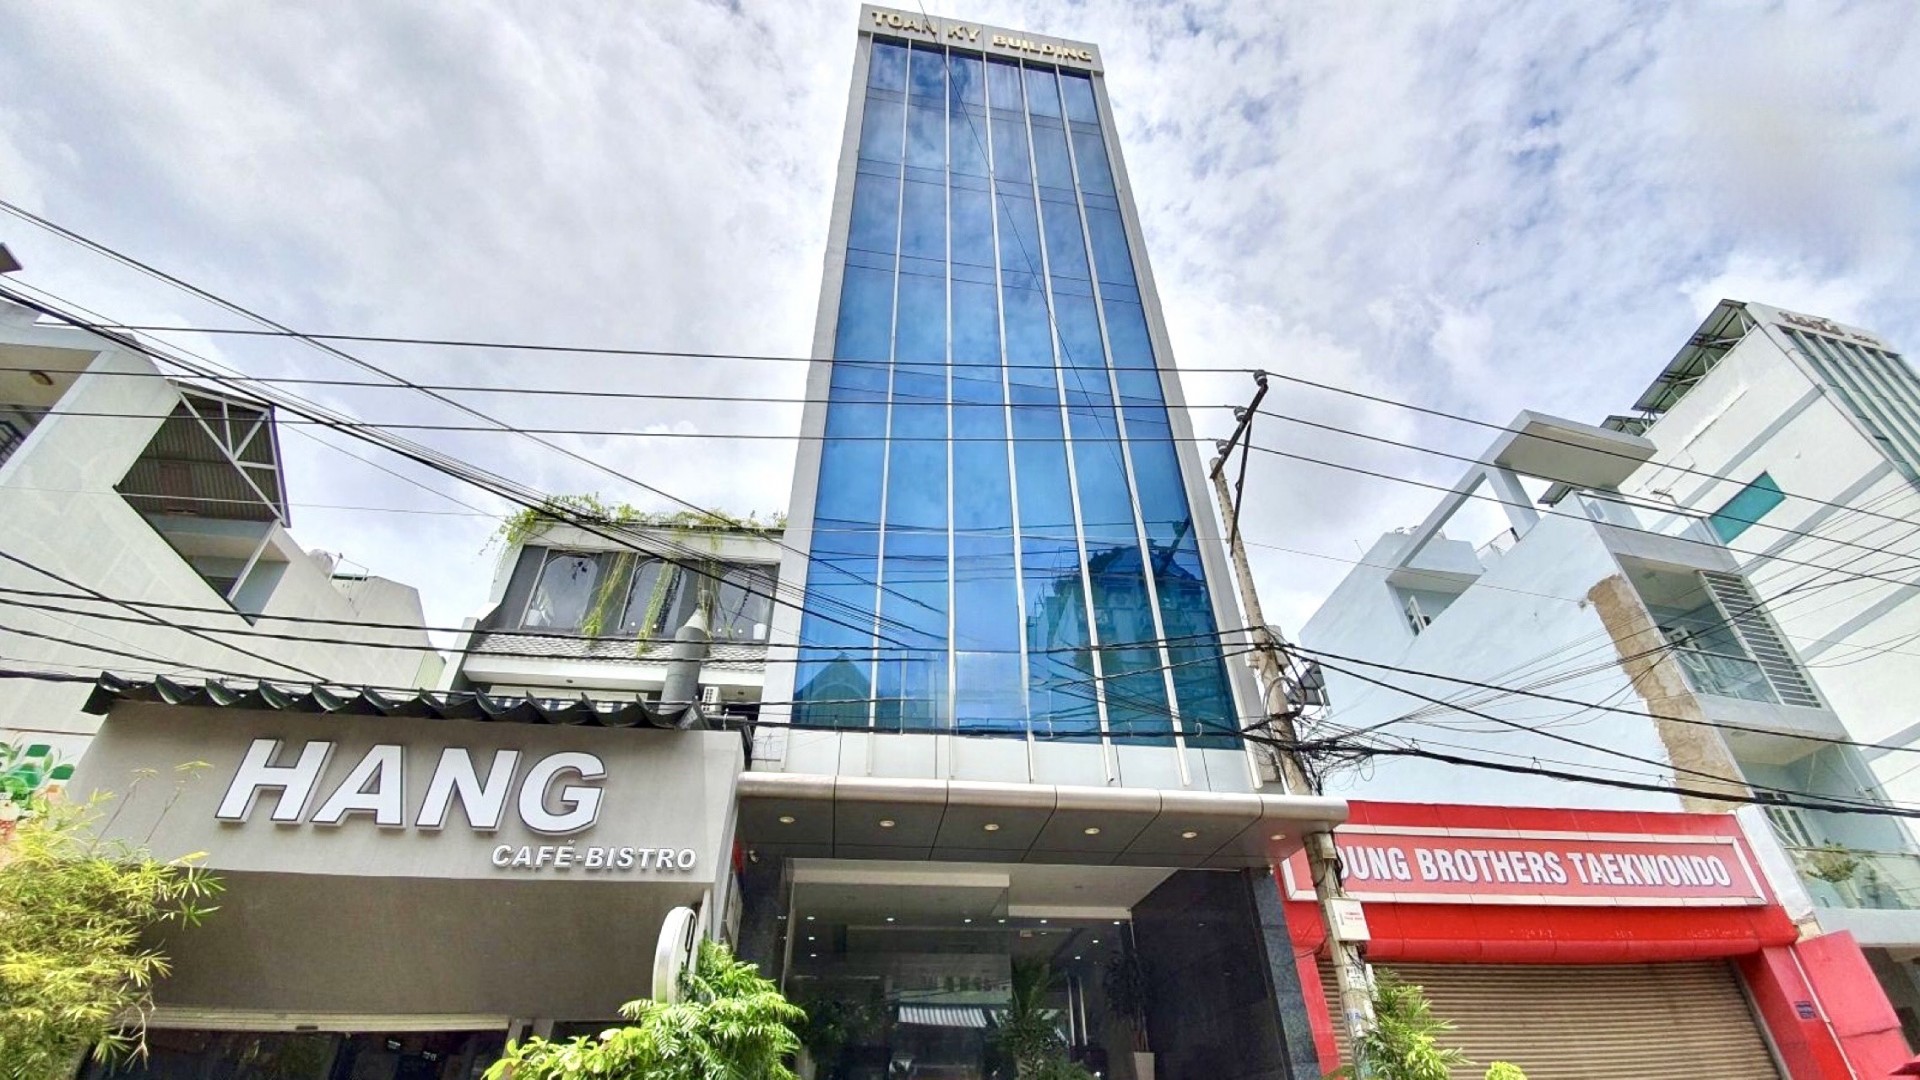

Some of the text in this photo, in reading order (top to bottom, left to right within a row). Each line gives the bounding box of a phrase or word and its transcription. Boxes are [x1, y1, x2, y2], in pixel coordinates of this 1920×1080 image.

[872, 11, 1092, 62] TOAN KY BUILDING
[215, 738, 607, 836] HANG
[1418, 848, 1568, 885] BROTHERS
[1568, 853, 1731, 887] TAEKWONDO
